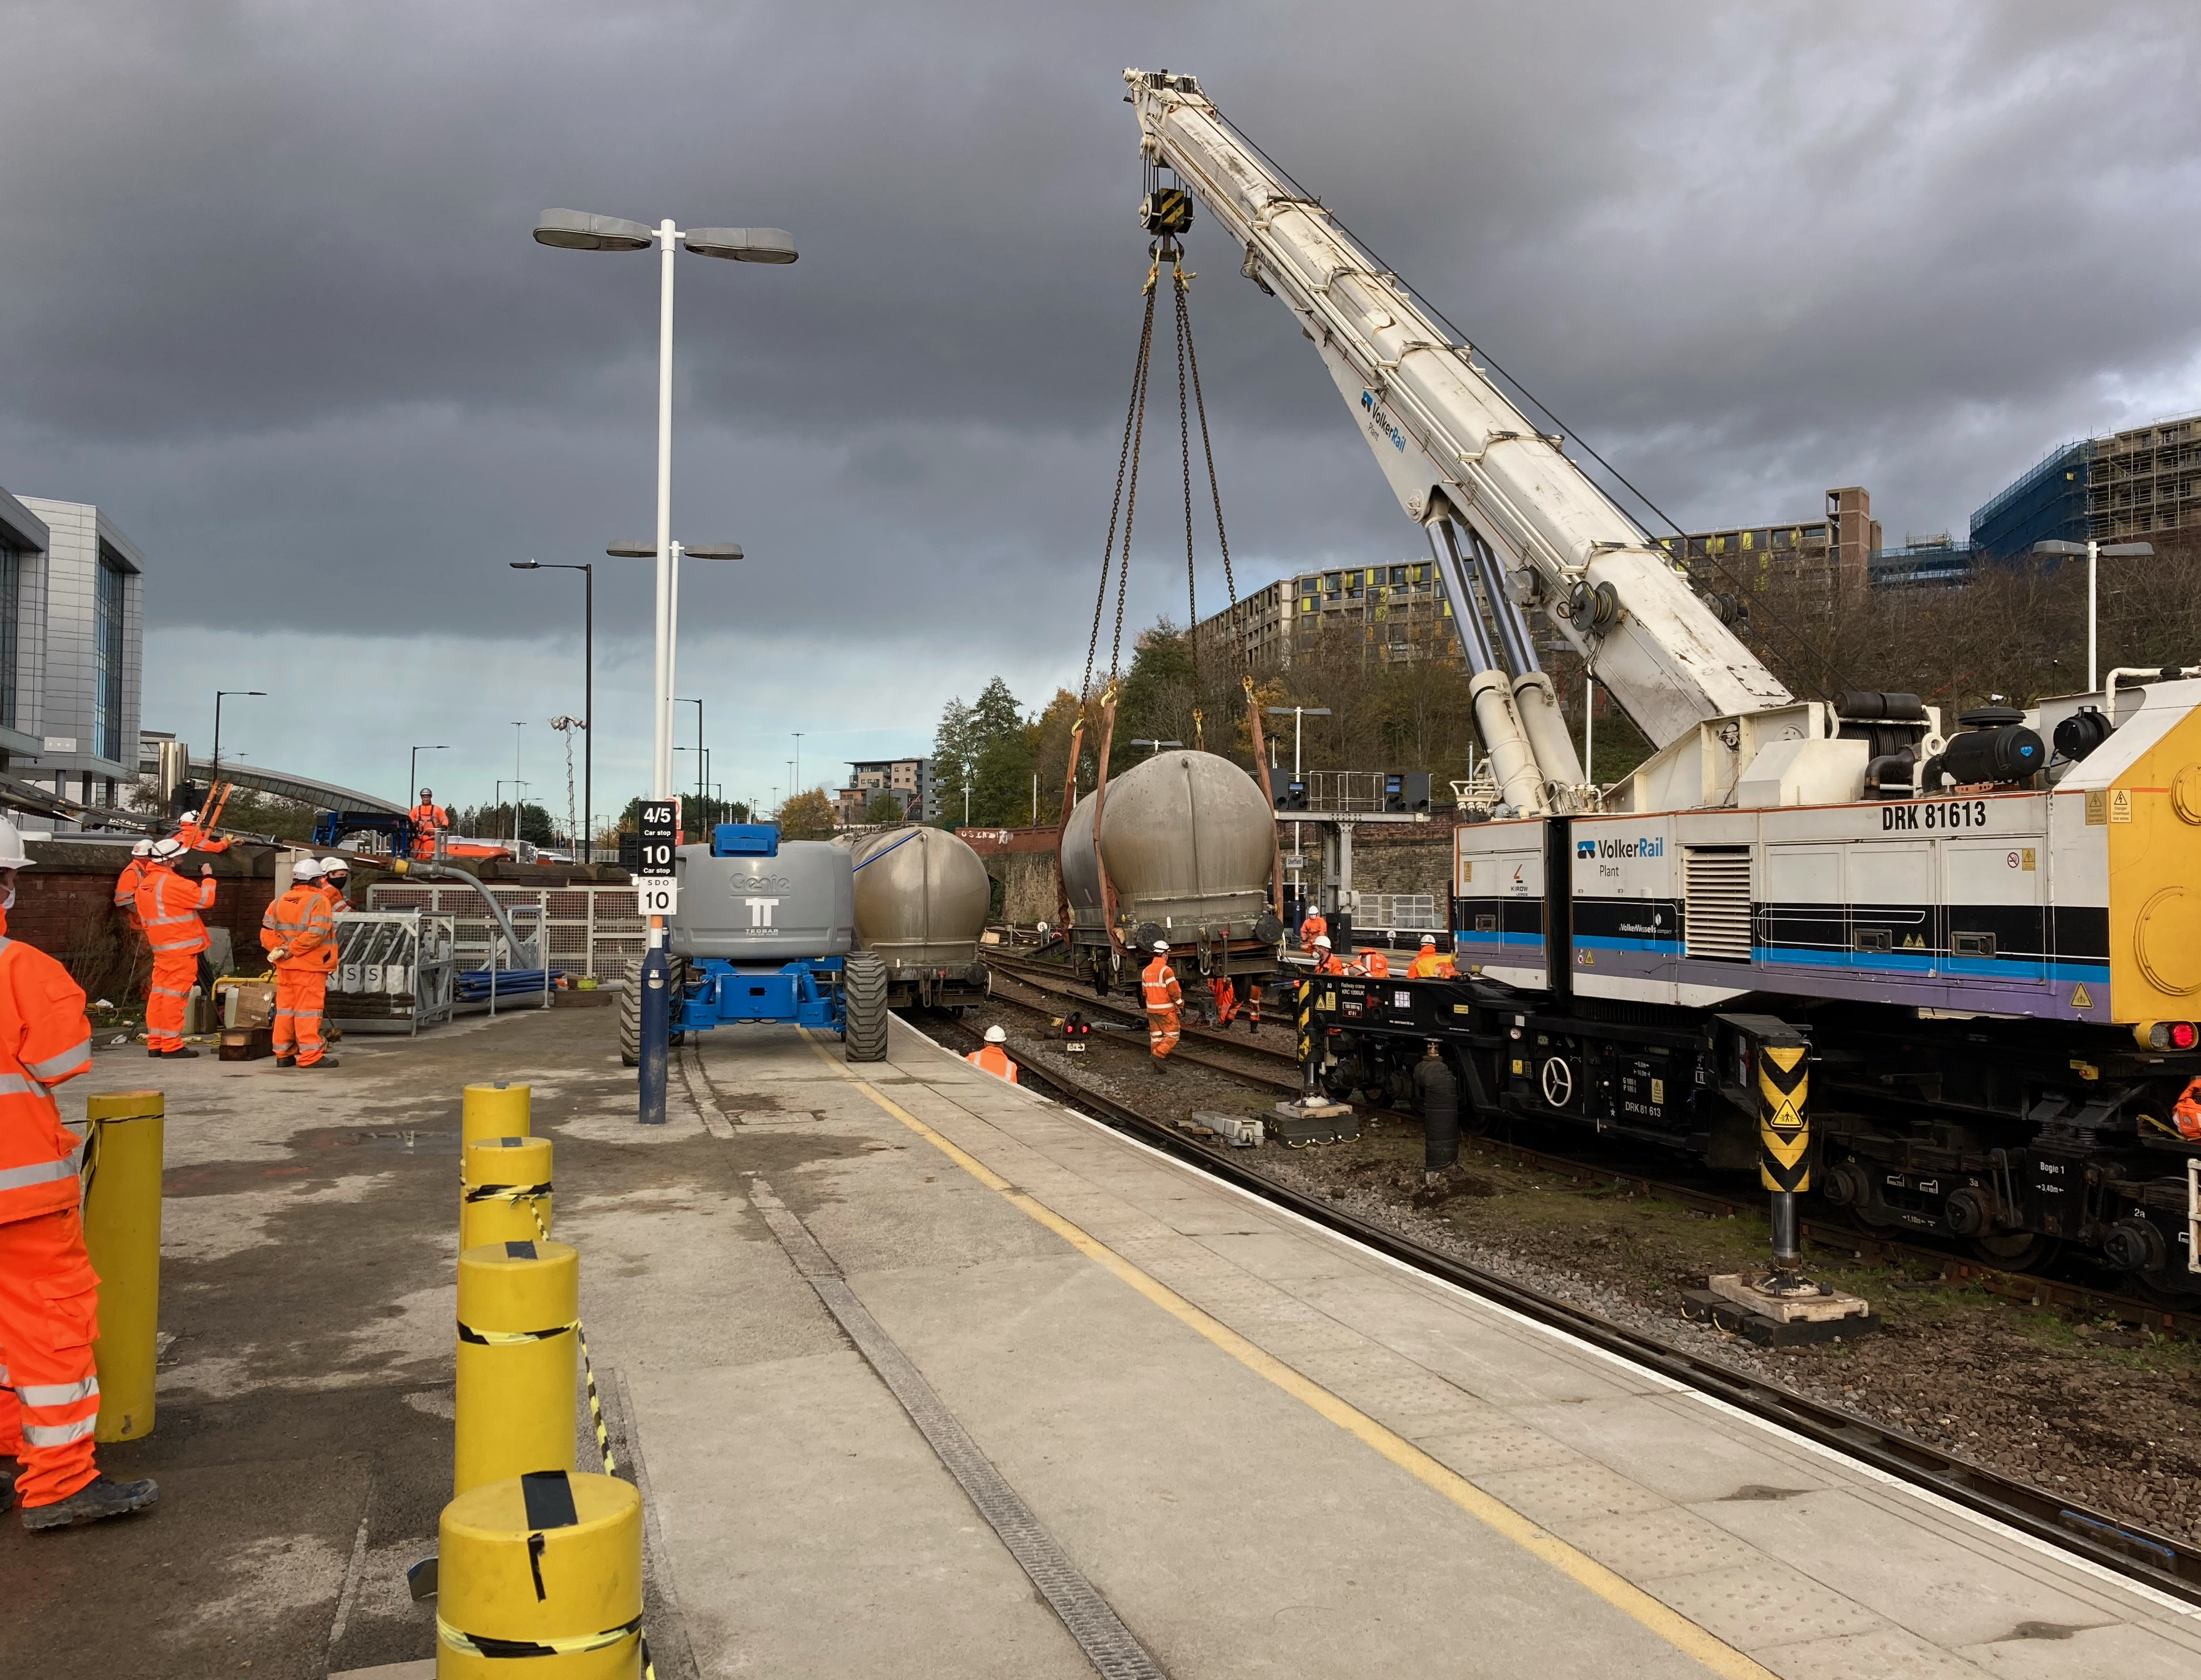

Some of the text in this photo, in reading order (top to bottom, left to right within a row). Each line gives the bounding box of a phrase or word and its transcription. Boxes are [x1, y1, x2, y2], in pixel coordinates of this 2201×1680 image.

[1367, 422, 1379, 441] Plant
[1372, 402, 1406, 453] VolkerRail
[643, 807, 671, 823] 4/5
[1882, 801, 1986, 831] DRK 81613
[643, 845, 670, 864] 10
[1598, 837, 1663, 858] VolkerRail
[1600, 865, 1619, 877] Plant
[730, 873, 790, 892] Genie
[646, 891, 669, 909] 10
[347, 968, 356, 980] S
[369, 968, 378, 981] S
[1625, 1101, 1661, 1117] DRK 81 613
[2040, 1162, 2064, 1174] Bogie 1
[1969, 1178, 1979, 1187] 3a
[2134, 1208, 2145, 1218] 2a
